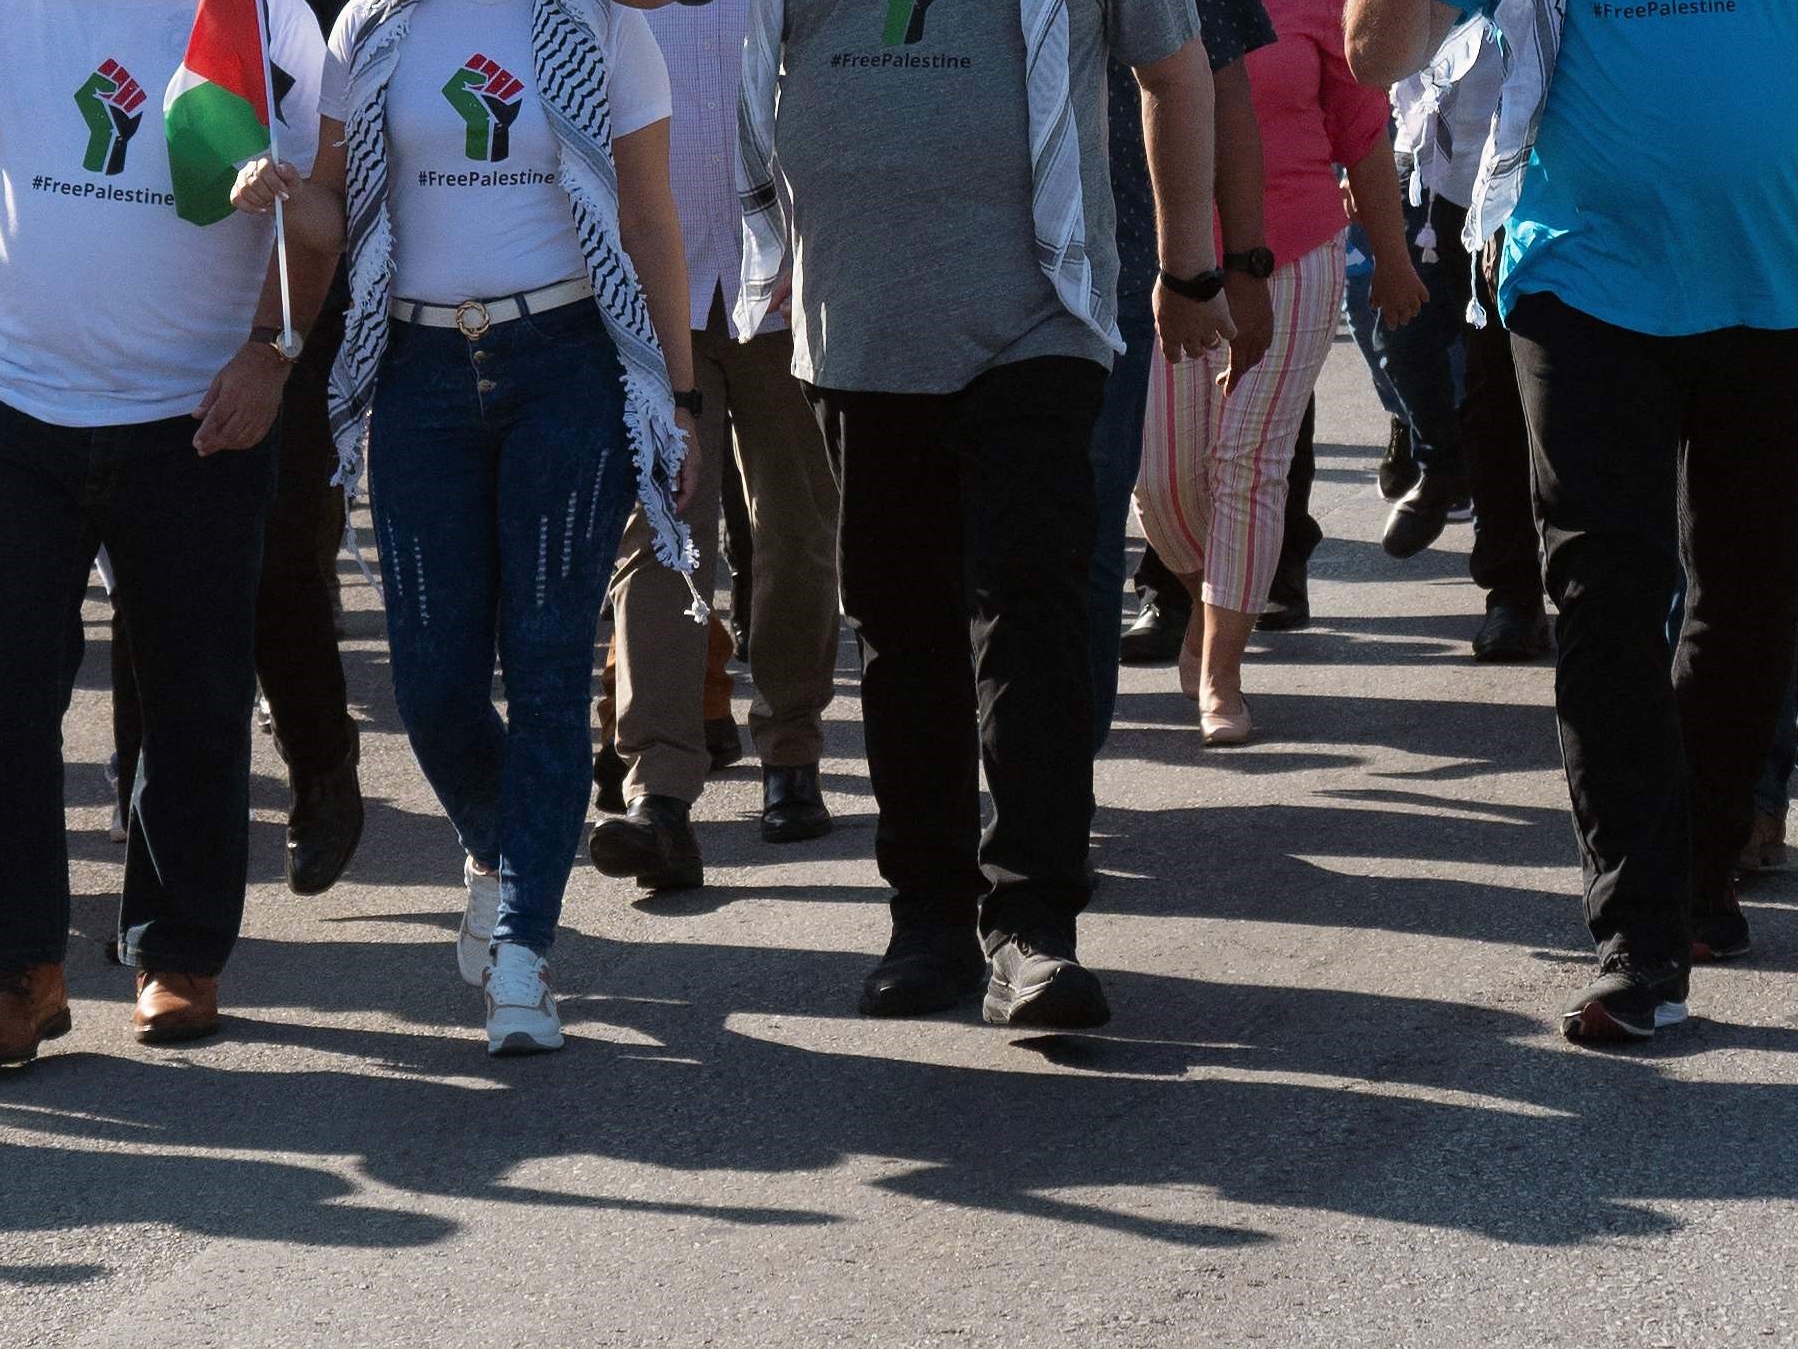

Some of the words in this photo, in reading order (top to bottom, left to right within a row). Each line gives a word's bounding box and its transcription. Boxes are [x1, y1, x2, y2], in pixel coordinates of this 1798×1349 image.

[830, 52, 972, 69] #FreePalestine
[418, 169, 556, 187] #FreePalestine
[32, 175, 175, 206] #FreePalestine
